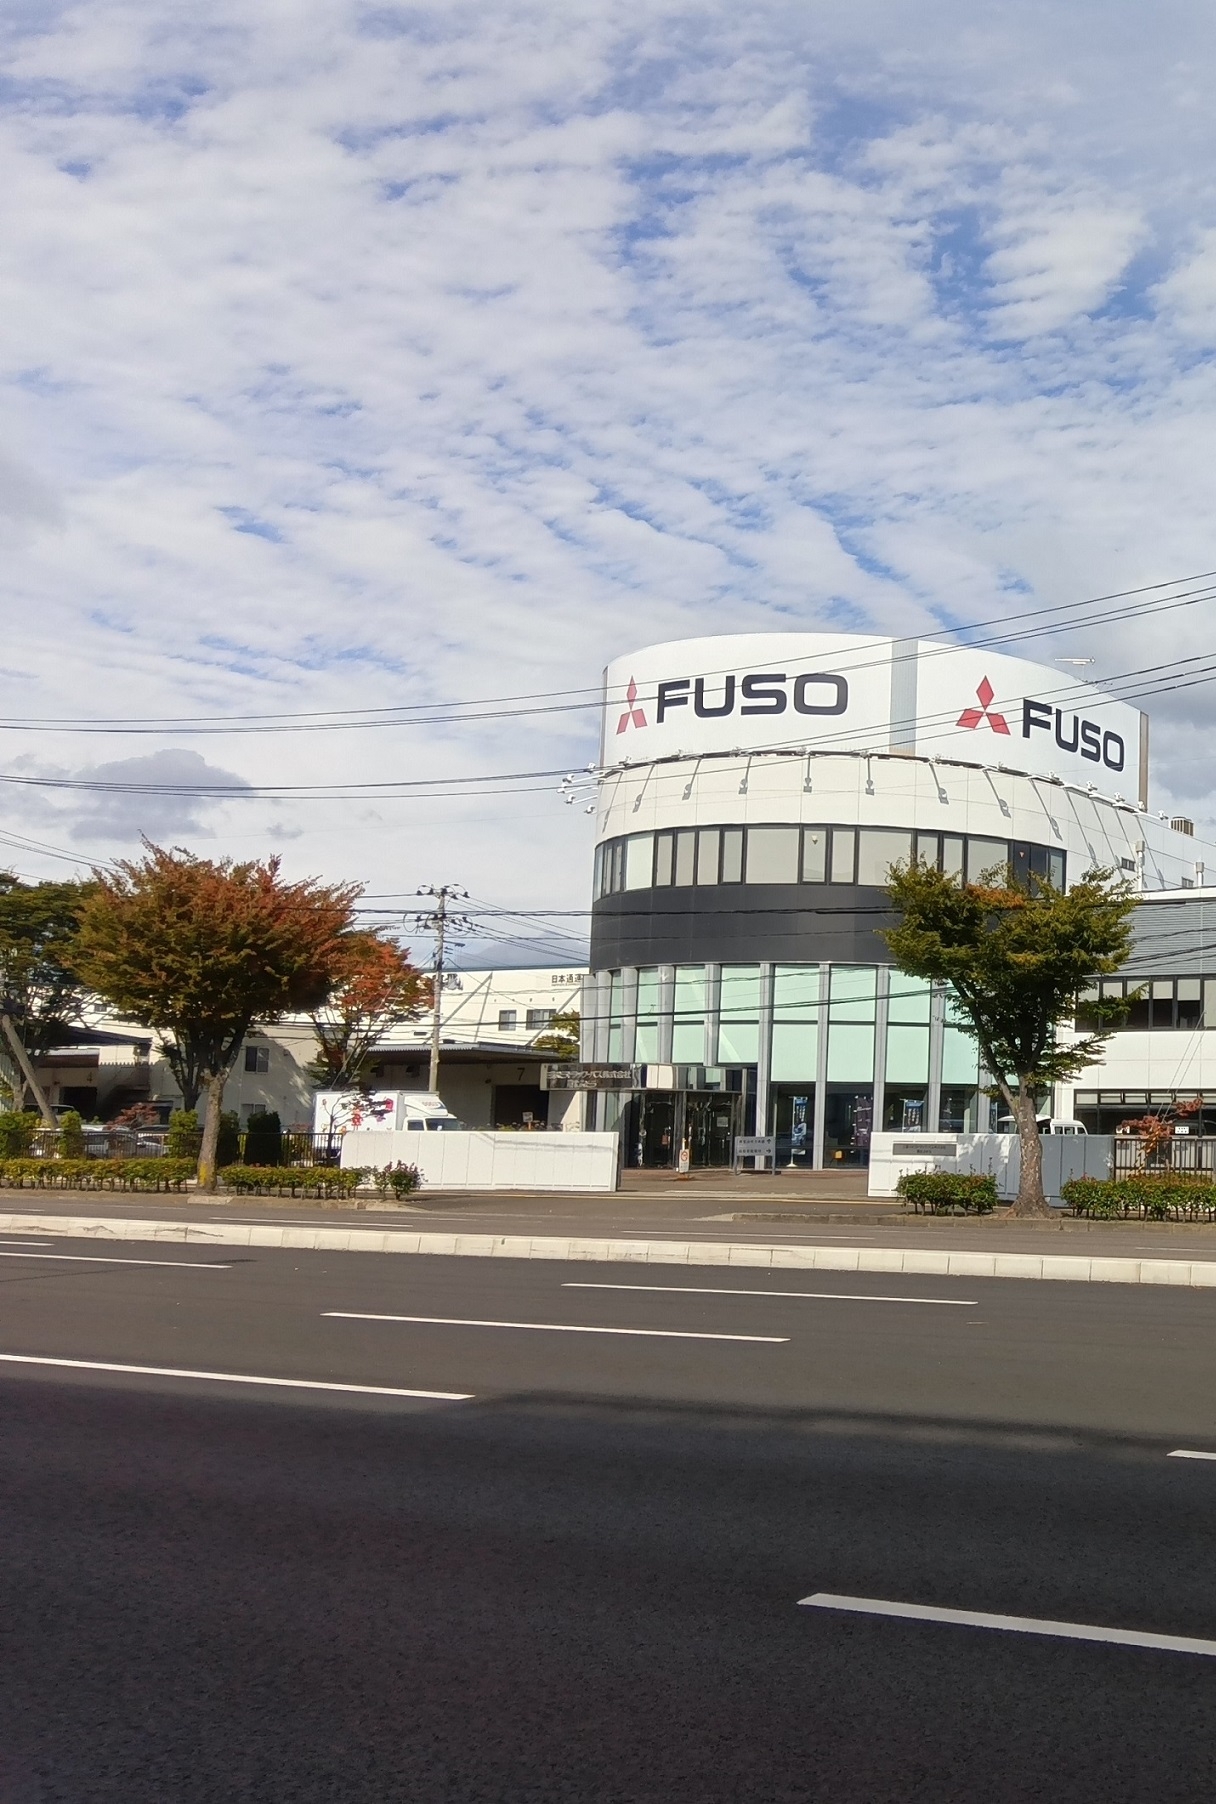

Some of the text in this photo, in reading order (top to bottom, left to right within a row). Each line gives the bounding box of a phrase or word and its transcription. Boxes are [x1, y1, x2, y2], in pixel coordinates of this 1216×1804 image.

[657, 673, 848, 723] FUSO
[1022, 698, 1125, 772] FUSO
[517, 1067, 525, 1081] 7
